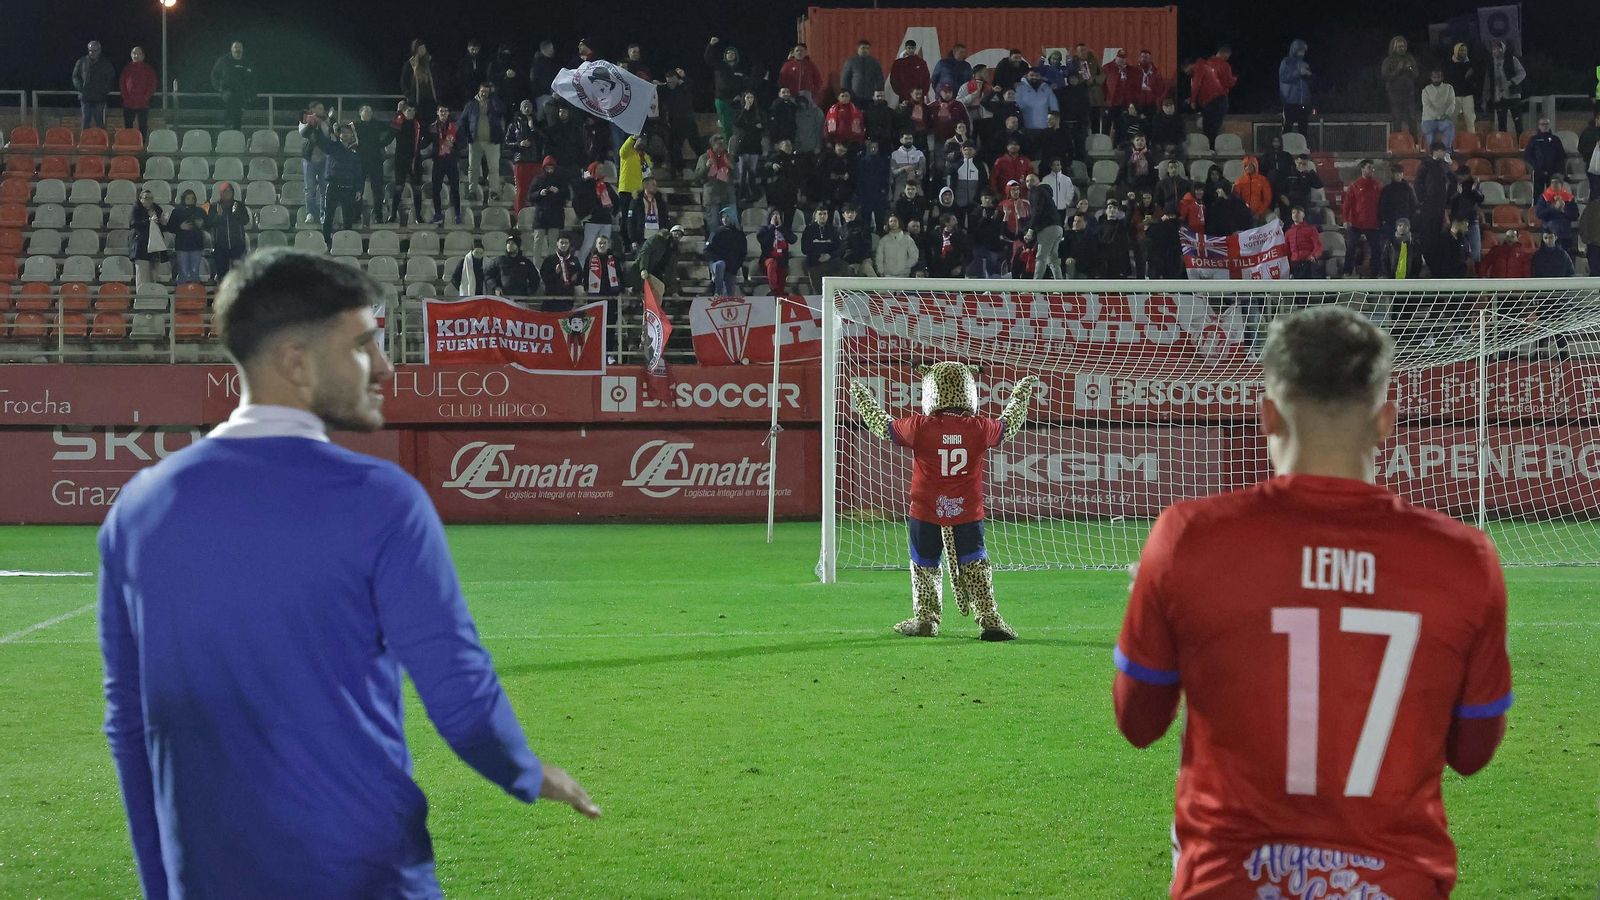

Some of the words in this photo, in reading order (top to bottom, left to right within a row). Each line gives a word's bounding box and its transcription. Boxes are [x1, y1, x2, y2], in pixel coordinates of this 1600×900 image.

[1191, 258, 1229, 267] FOREST
[1231, 257, 1255, 267] TILL
[436, 316, 554, 341] KOMANDO
[392, 370, 510, 397] FUEGO
[642, 382, 801, 409] SOCCER
[0, 389, 71, 414] rocha
[438, 403, 482, 417] CLUB
[938, 448, 968, 477] 12
[993, 452, 1158, 482] KGM
[577, 489, 614, 500] transporte
[755, 488, 792, 498] tranporte
[1271, 606, 1422, 798] 17
